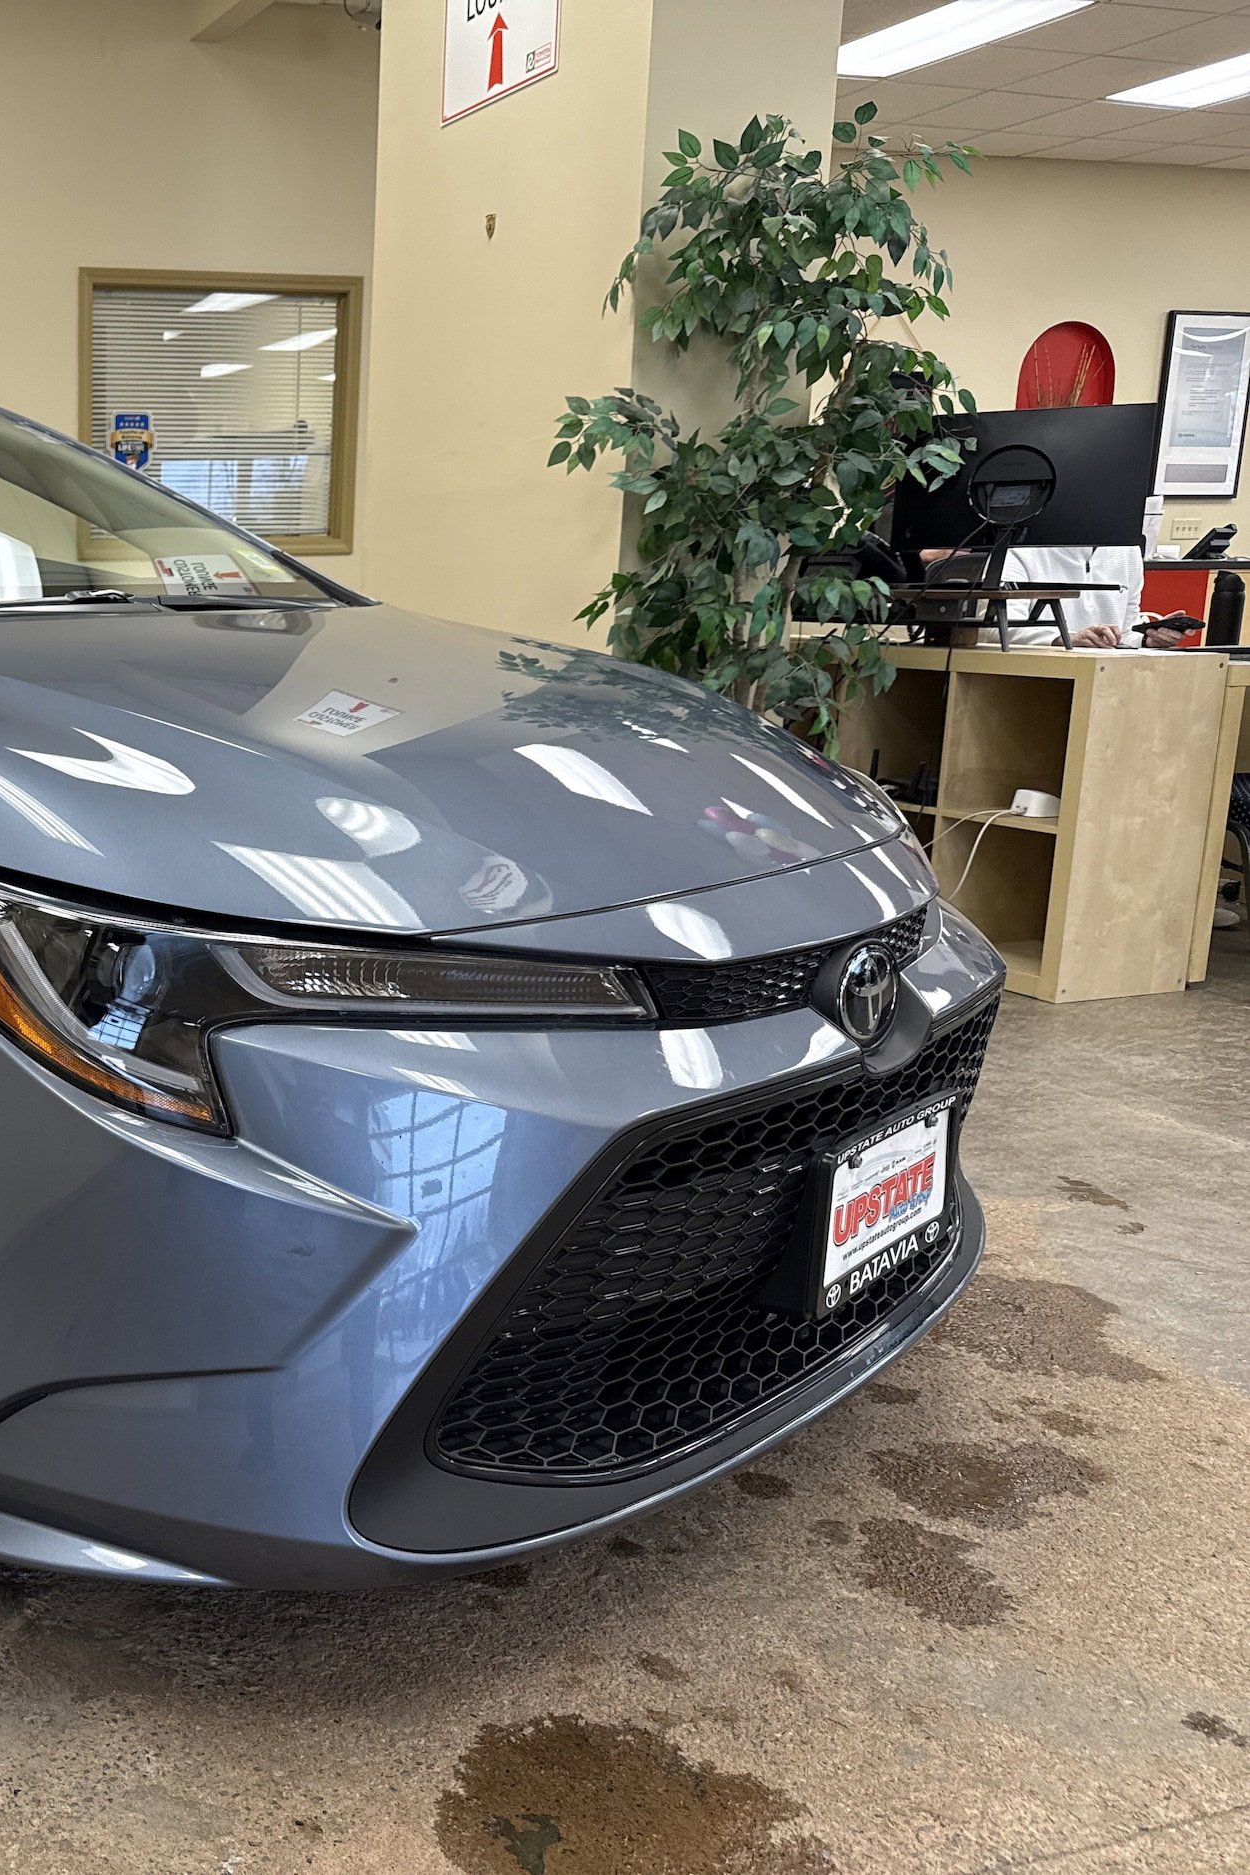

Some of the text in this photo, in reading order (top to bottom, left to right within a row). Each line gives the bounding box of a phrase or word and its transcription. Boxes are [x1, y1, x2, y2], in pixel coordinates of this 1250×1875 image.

[837, 1130, 885, 1165] UPSTATE
[884, 1116, 915, 1138] AUTO
[916, 1096, 957, 1121] GROUP
[833, 1151, 936, 1247] UPSTATE
[842, 1207, 922, 1261] www.upstateautogroup.com
[850, 1234, 919, 1295] BATAVIA
